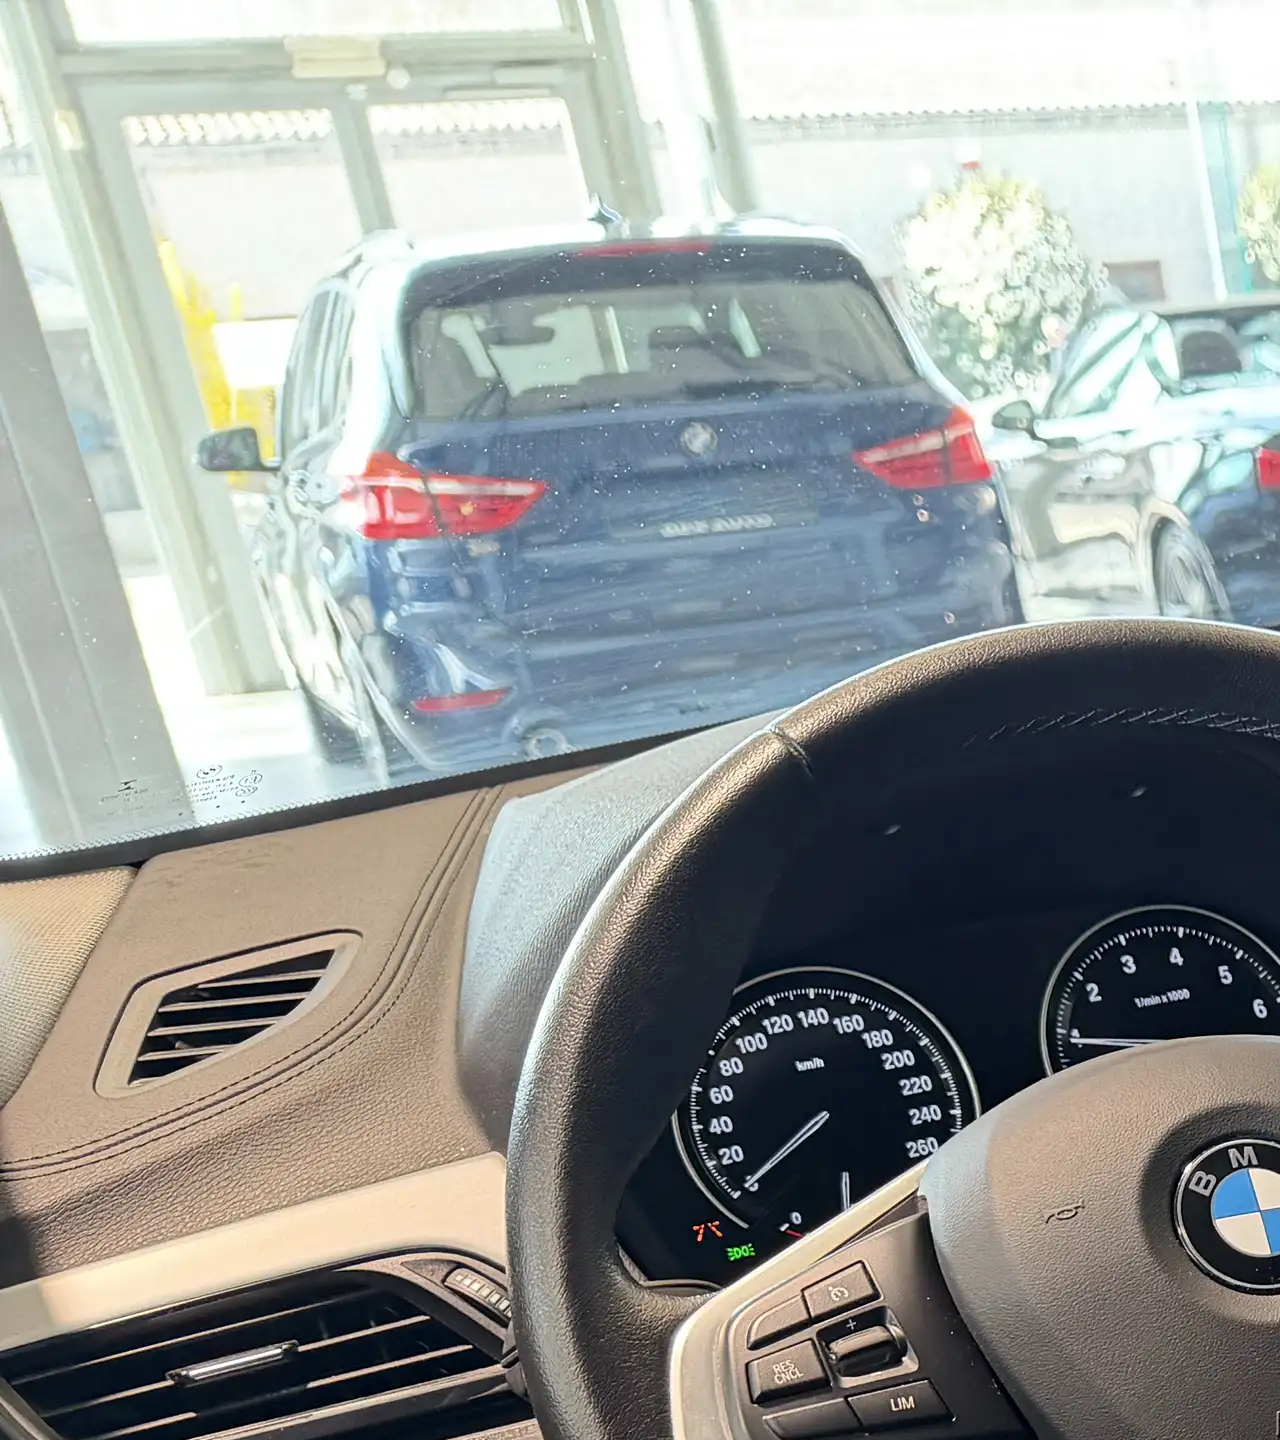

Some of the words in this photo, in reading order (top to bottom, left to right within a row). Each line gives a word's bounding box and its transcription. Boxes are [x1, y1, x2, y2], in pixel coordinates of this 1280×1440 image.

[1119, 954, 1137, 974] 3
[1169, 947, 1184, 966] 4
[1217, 965, 1233, 985] 5
[1085, 982, 1102, 1003] 2
[797, 1007, 830, 1028] 140
[1252, 998, 1268, 1019] 6
[762, 1014, 794, 1035] 120
[833, 1014, 865, 1034] 160
[735, 1032, 768, 1054] 100
[861, 1029, 894, 1049] 180
[719, 1056, 744, 1077] 80
[795, 1057, 825, 1072] km/h
[881, 1050, 915, 1070] 200
[709, 1085, 734, 1104] 60
[899, 1075, 933, 1096] 220
[908, 1104, 942, 1126] 240
[709, 1116, 734, 1135] 40
[718, 1145, 744, 1165] 20
[905, 1137, 939, 1158] 260
[772, 1359, 796, 1374] RES
[774, 1368, 804, 1384] CNCL
[890, 1395, 915, 1411] LIM
